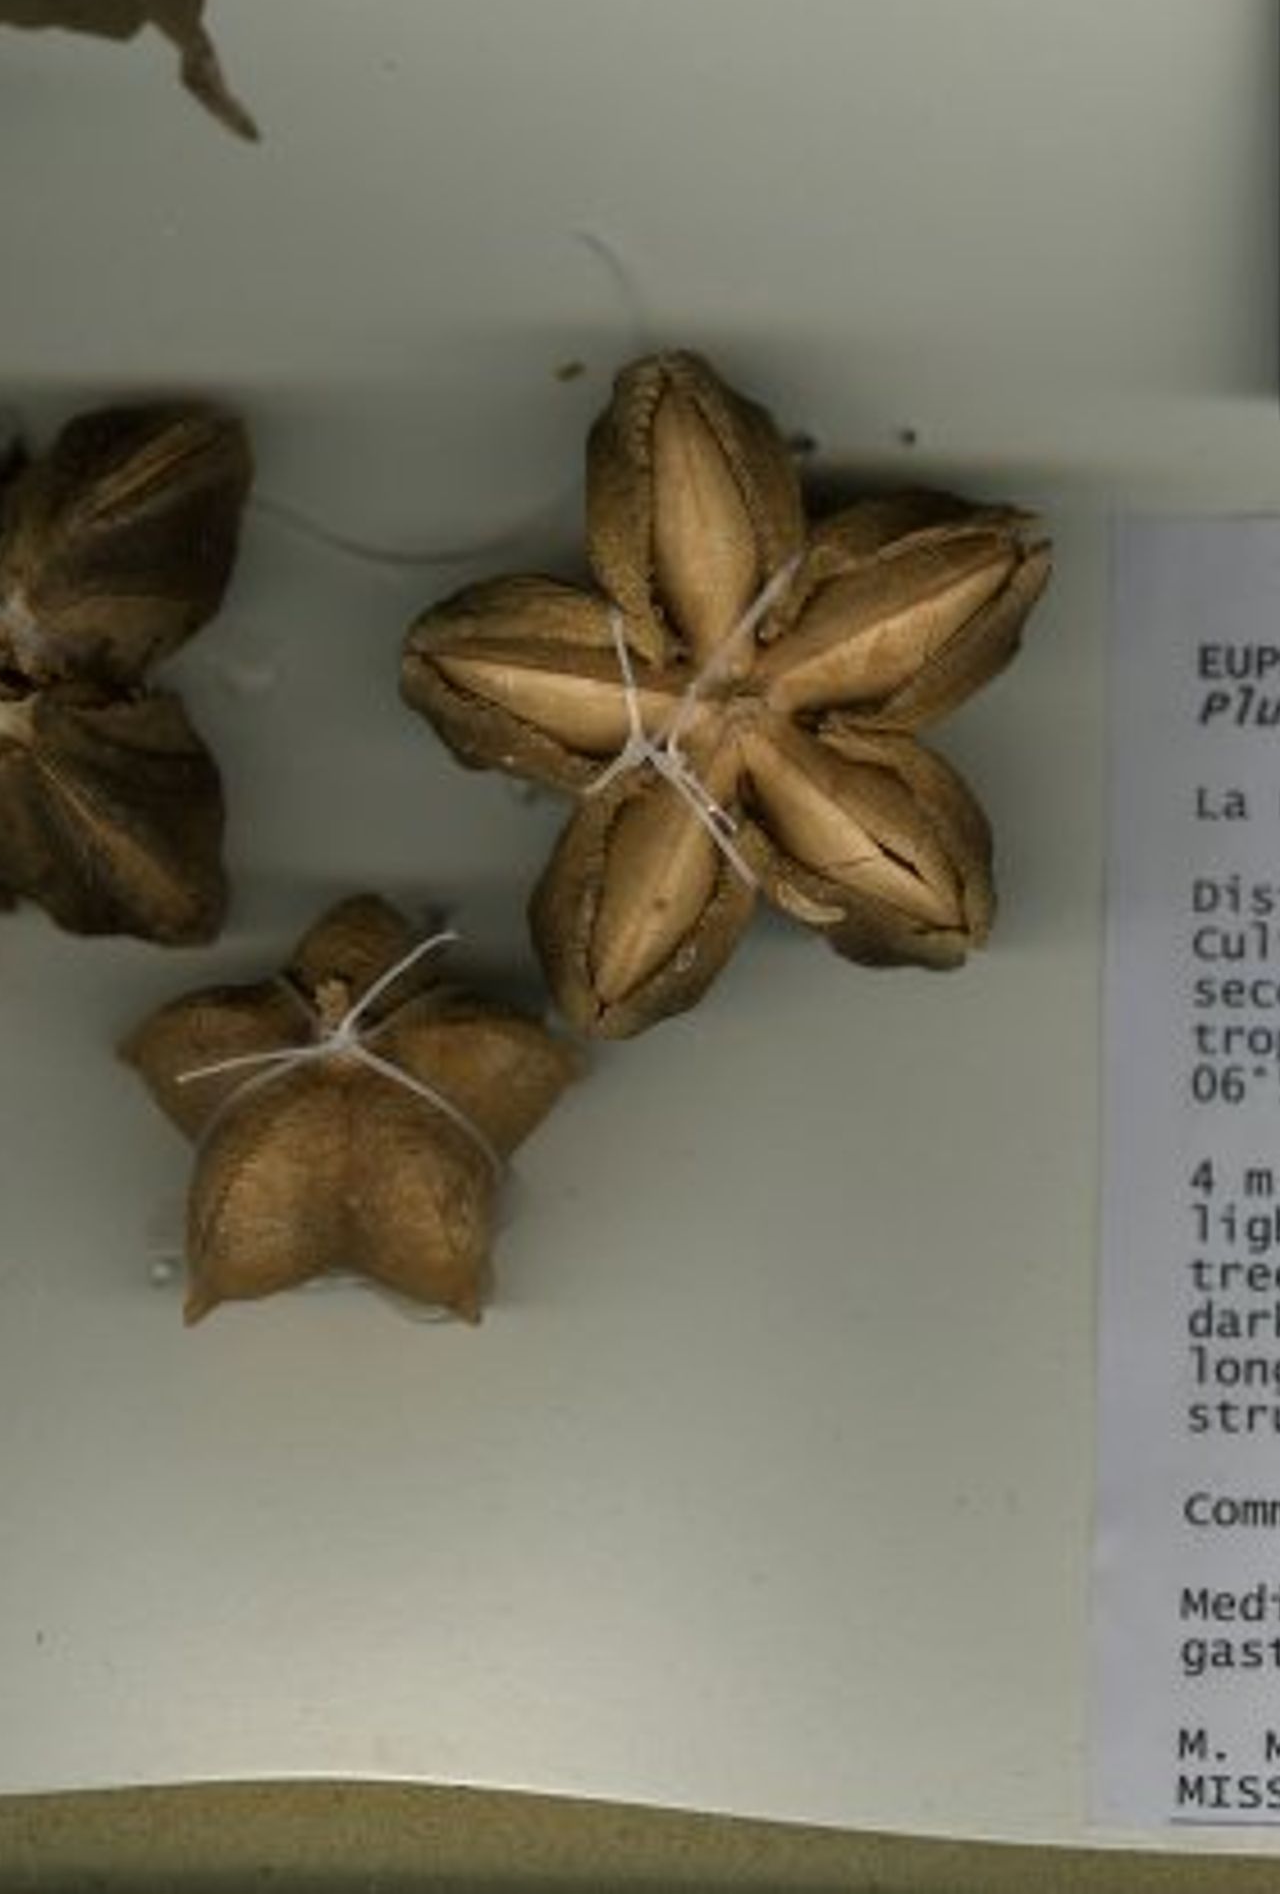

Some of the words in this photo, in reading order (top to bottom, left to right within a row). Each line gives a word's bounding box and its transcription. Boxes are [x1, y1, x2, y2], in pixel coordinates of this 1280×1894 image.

[1195, 786, 1248, 821] La
[1189, 1159, 1215, 1196] 4
[1244, 1168, 1274, 1197] m
[1178, 1728, 1227, 1762] M.
